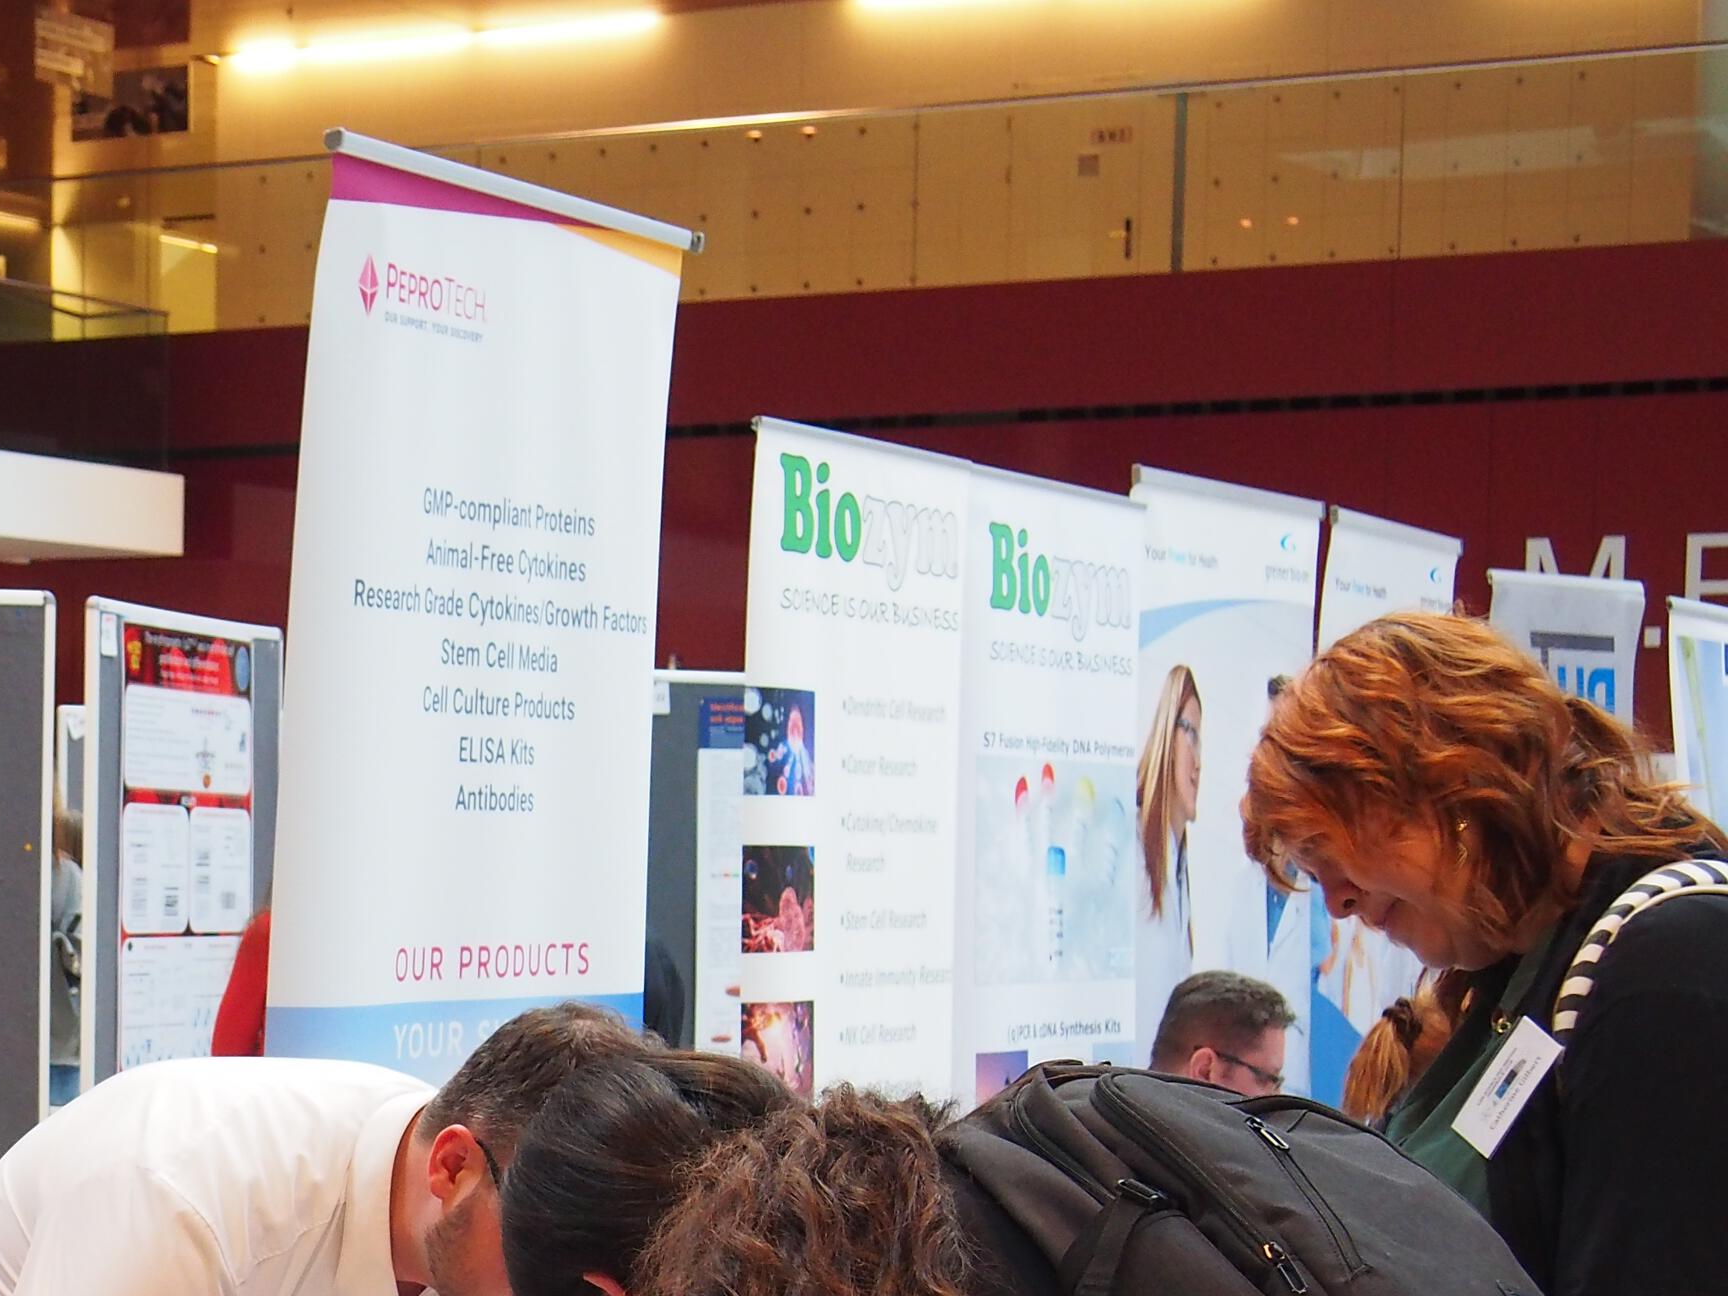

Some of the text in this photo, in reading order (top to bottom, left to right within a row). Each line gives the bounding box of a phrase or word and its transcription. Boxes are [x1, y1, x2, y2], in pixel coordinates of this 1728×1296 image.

[423, 487, 595, 536] GMP-compliant Proteins
[780, 452, 959, 593] Biozym
[426, 537, 586, 583] Animal-Free Cytokines
[354, 578, 647, 635] Research Grade Cytokines/Growth Factors
[441, 638, 558, 673] Stem Cell Media
[423, 685, 576, 721] Cell Culture Products
[459, 736, 535, 767] ELISA Kits
[455, 784, 534, 813] Antibodies
[395, 942, 590, 983] OUR PRODUCTS
[394, 1020, 463, 1061] YOUR
[1060, 1020, 1101, 1040] Synthesis
[1104, 1017, 1121, 1035] Kits
